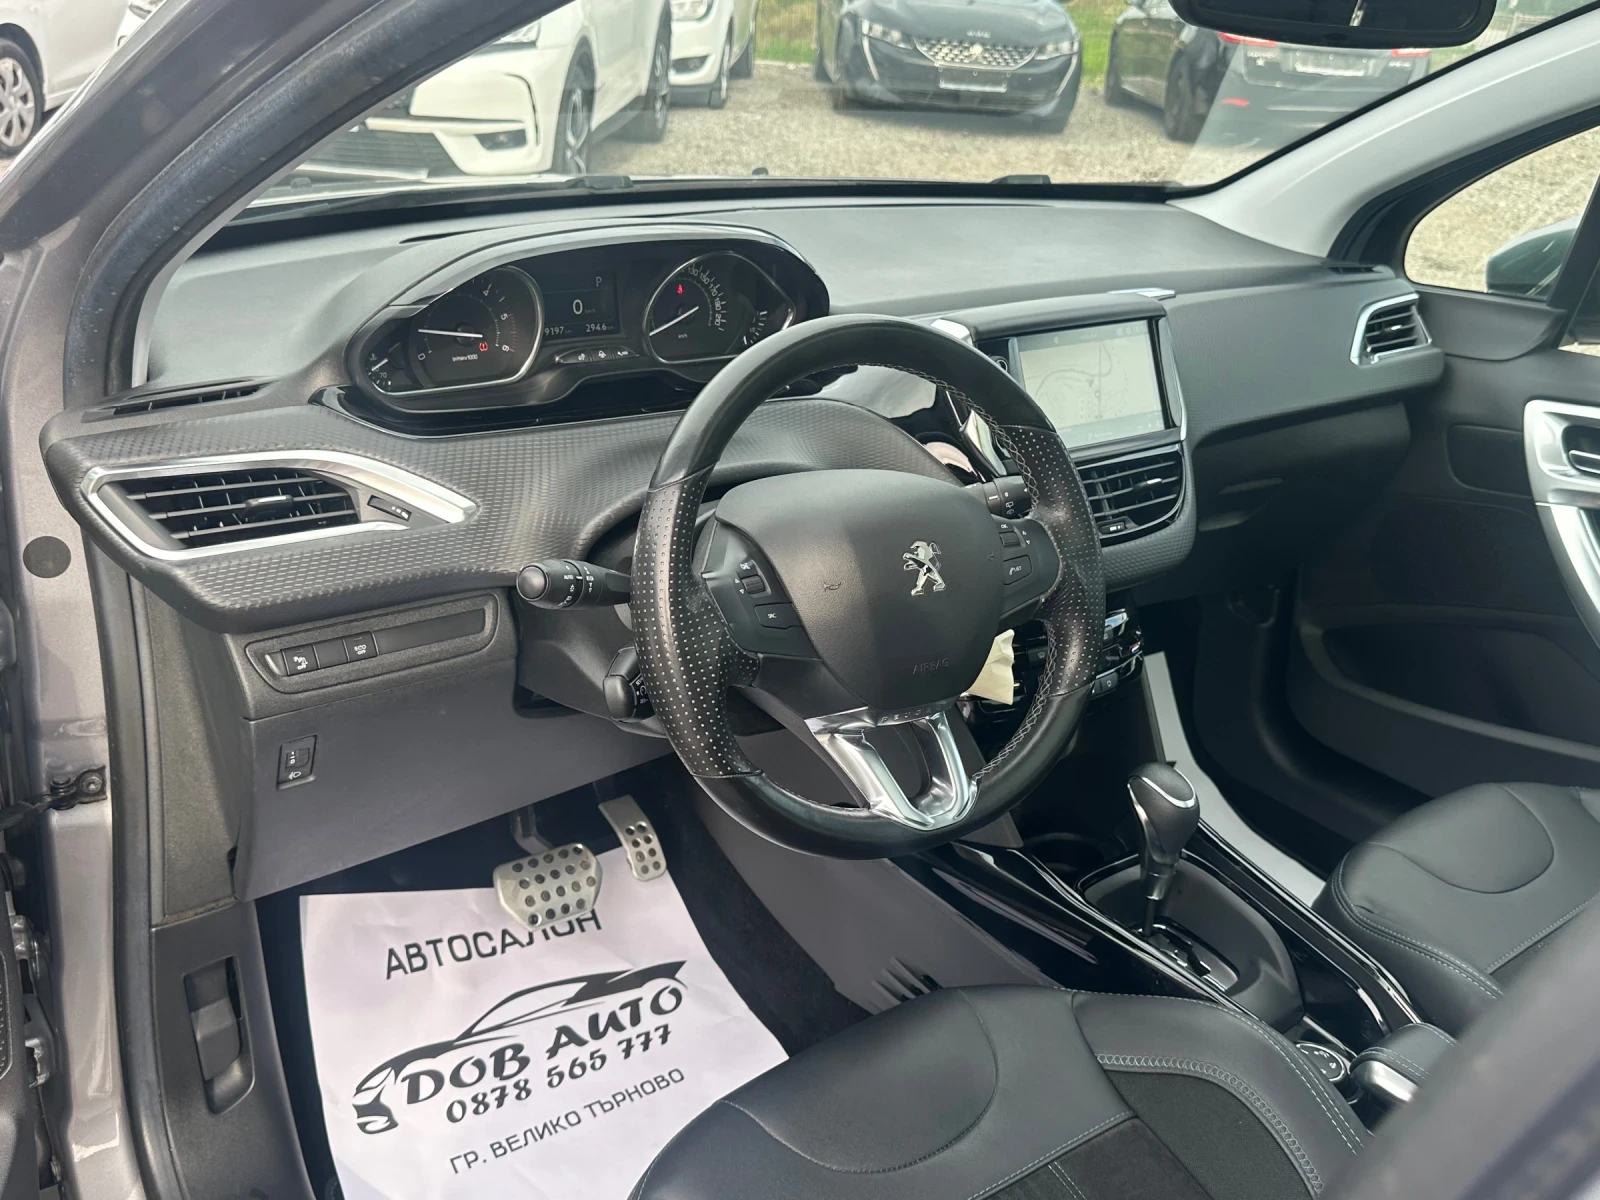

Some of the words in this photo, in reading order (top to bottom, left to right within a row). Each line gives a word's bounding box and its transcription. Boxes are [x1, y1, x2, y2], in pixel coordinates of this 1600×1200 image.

[595, 276, 603, 287] P
[699, 271, 710, 285] 150
[708, 283, 718, 297] 170
[572, 299, 583, 315] 0
[544, 326, 565, 336] 9197
[354, 644, 367, 652] ECO
[912, 657, 949, 675] AIRBAG
[401, 1043, 530, 1105] DOB
[446, 1078, 532, 1123] 0878
[547, 1048, 607, 1088] 565
[617, 1023, 671, 1060] 777
[450, 1150, 487, 1174] ГР.
[489, 1110, 582, 1159] ВЕЛИКО
[583, 1068, 685, 1118] ТЪРНОВО
